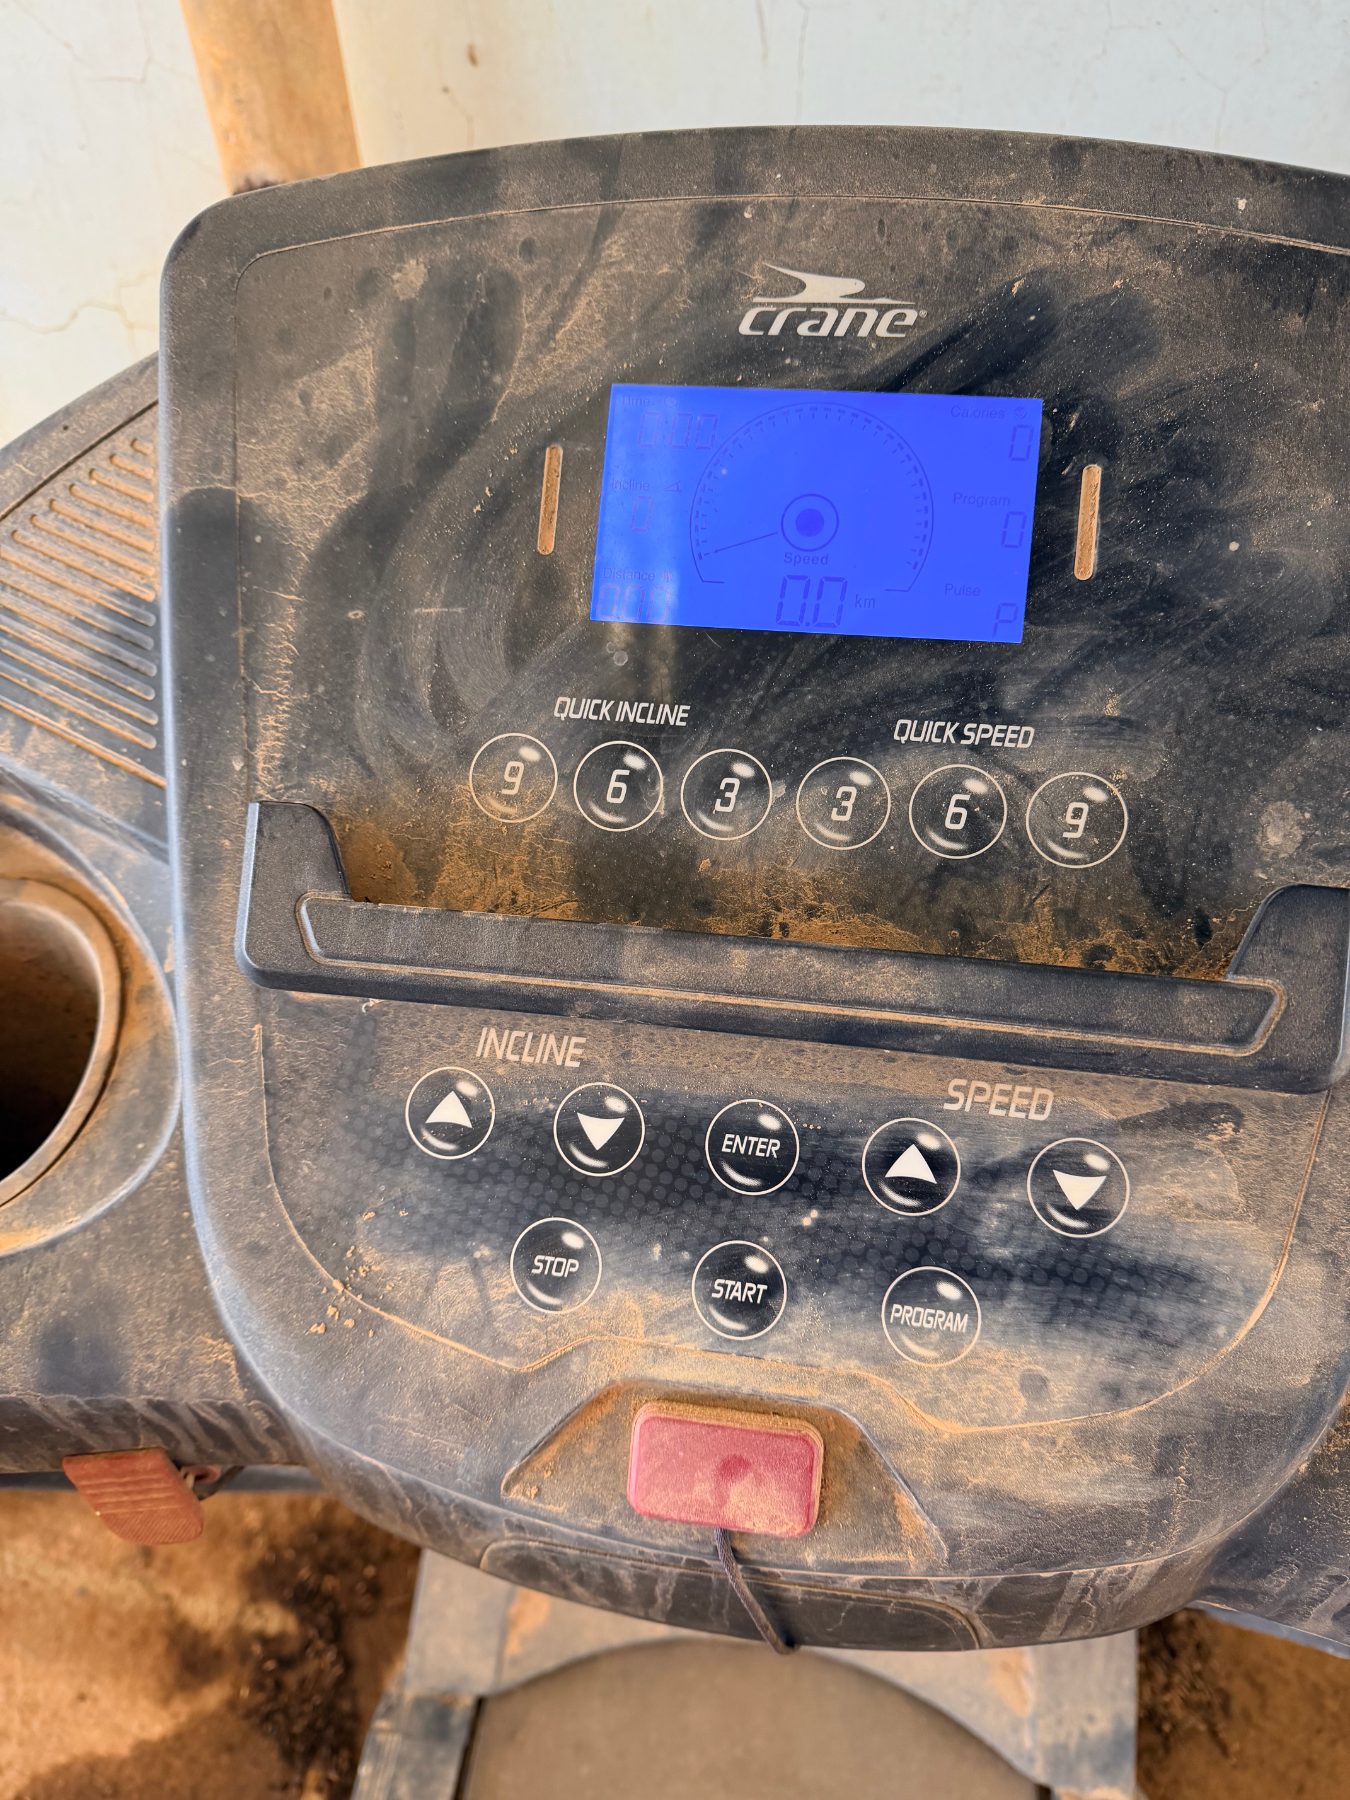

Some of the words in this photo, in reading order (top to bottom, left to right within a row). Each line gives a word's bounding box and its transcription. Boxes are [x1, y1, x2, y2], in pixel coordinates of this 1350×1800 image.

[738, 306, 918, 338] crane
[950, 405, 1005, 419] Calories
[1008, 424, 1034, 462] 0
[611, 479, 651, 492] Incline
[952, 491, 1010, 508] Program
[1000, 511, 1028, 549] 0
[602, 567, 656, 581] Distance
[783, 551, 829, 570] Speed
[776, 574, 848, 627] 0.0
[854, 595, 876, 610] km
[944, 582, 982, 597] Pulse
[992, 601, 1018, 639] P
[553, 696, 614, 721] QUICK
[615, 701, 690, 727] INCLINE
[893, 719, 959, 744] QUICK
[960, 723, 1035, 749] SPEED
[502, 761, 525, 795] 9
[606, 769, 630, 804] 6
[714, 777, 741, 813] 3
[831, 786, 857, 822] 3
[945, 794, 970, 830] 6
[1062, 802, 1089, 838] 9
[475, 1027, 587, 1068] INCLINE
[943, 1078, 1055, 1121] SPEED
[721, 1134, 781, 1158] ENTER
[531, 1255, 580, 1278] STOP
[711, 1279, 767, 1304] START
[890, 1304, 969, 1333] PROGRAM
